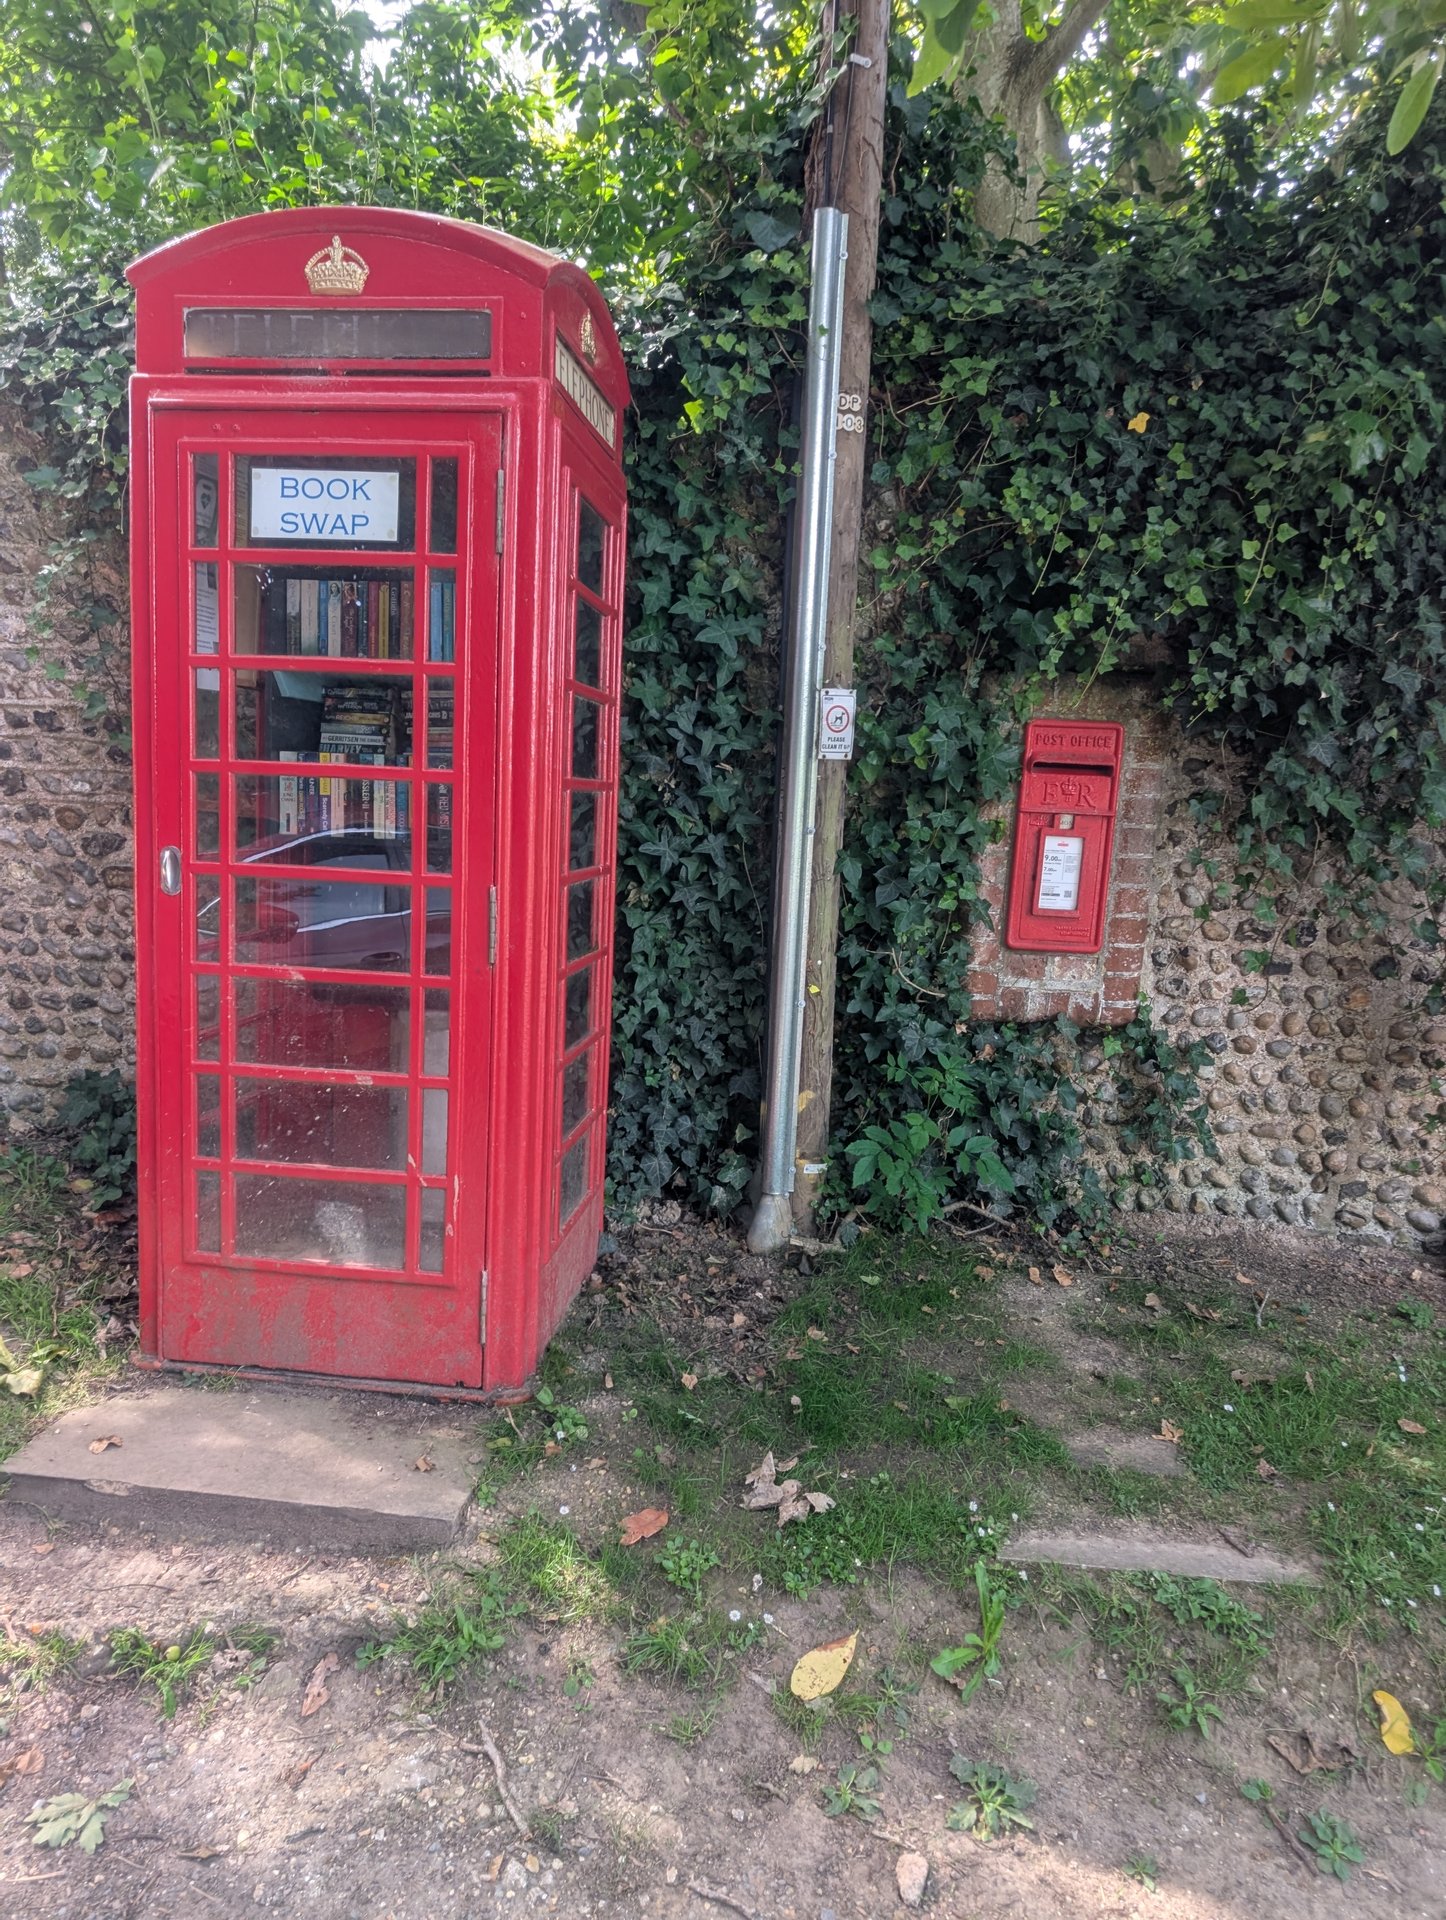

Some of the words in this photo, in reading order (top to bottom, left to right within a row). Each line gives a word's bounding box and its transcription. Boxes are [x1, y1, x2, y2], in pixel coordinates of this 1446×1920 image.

[559, 350, 610, 442] ELEPHONE
[840, 395, 859, 409] DP
[280, 477, 372, 500] BOOK
[280, 512, 370, 536] SWAP
[1035, 733, 1067, 746] POST
[1070, 734, 1112, 749] OFFICE
[1041, 781, 1059, 806] E
[1075, 783, 1097, 809] R
[320, 797, 328, 820] Scaredy
